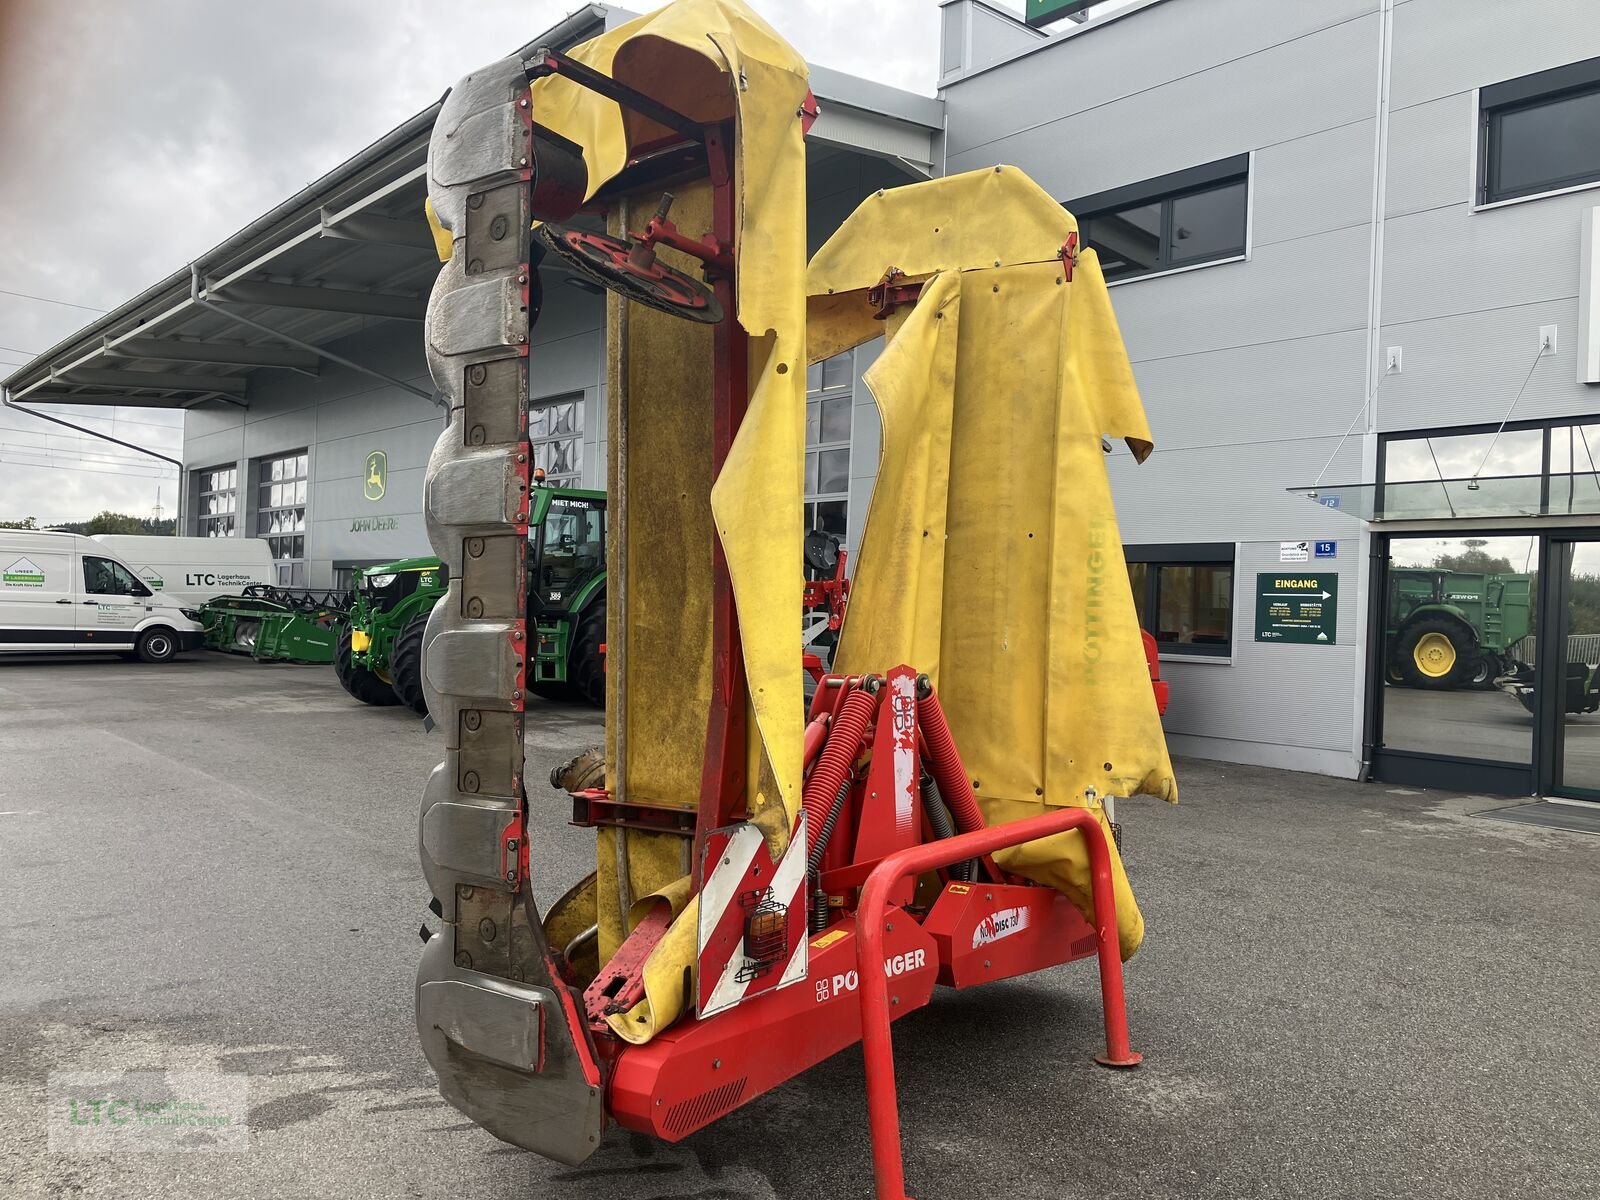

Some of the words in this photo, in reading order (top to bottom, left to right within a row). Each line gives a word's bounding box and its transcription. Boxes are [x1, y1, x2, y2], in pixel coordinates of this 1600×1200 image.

[551, 499, 569, 507] MIET
[569, 500, 589, 509] MICH!
[350, 518, 371, 532] JOHN
[1320, 543, 1331, 552] 15
[186, 573, 215, 586] LTC
[1275, 579, 1318, 589] EINGANG
[832, 948, 926, 997] PÖNGER
